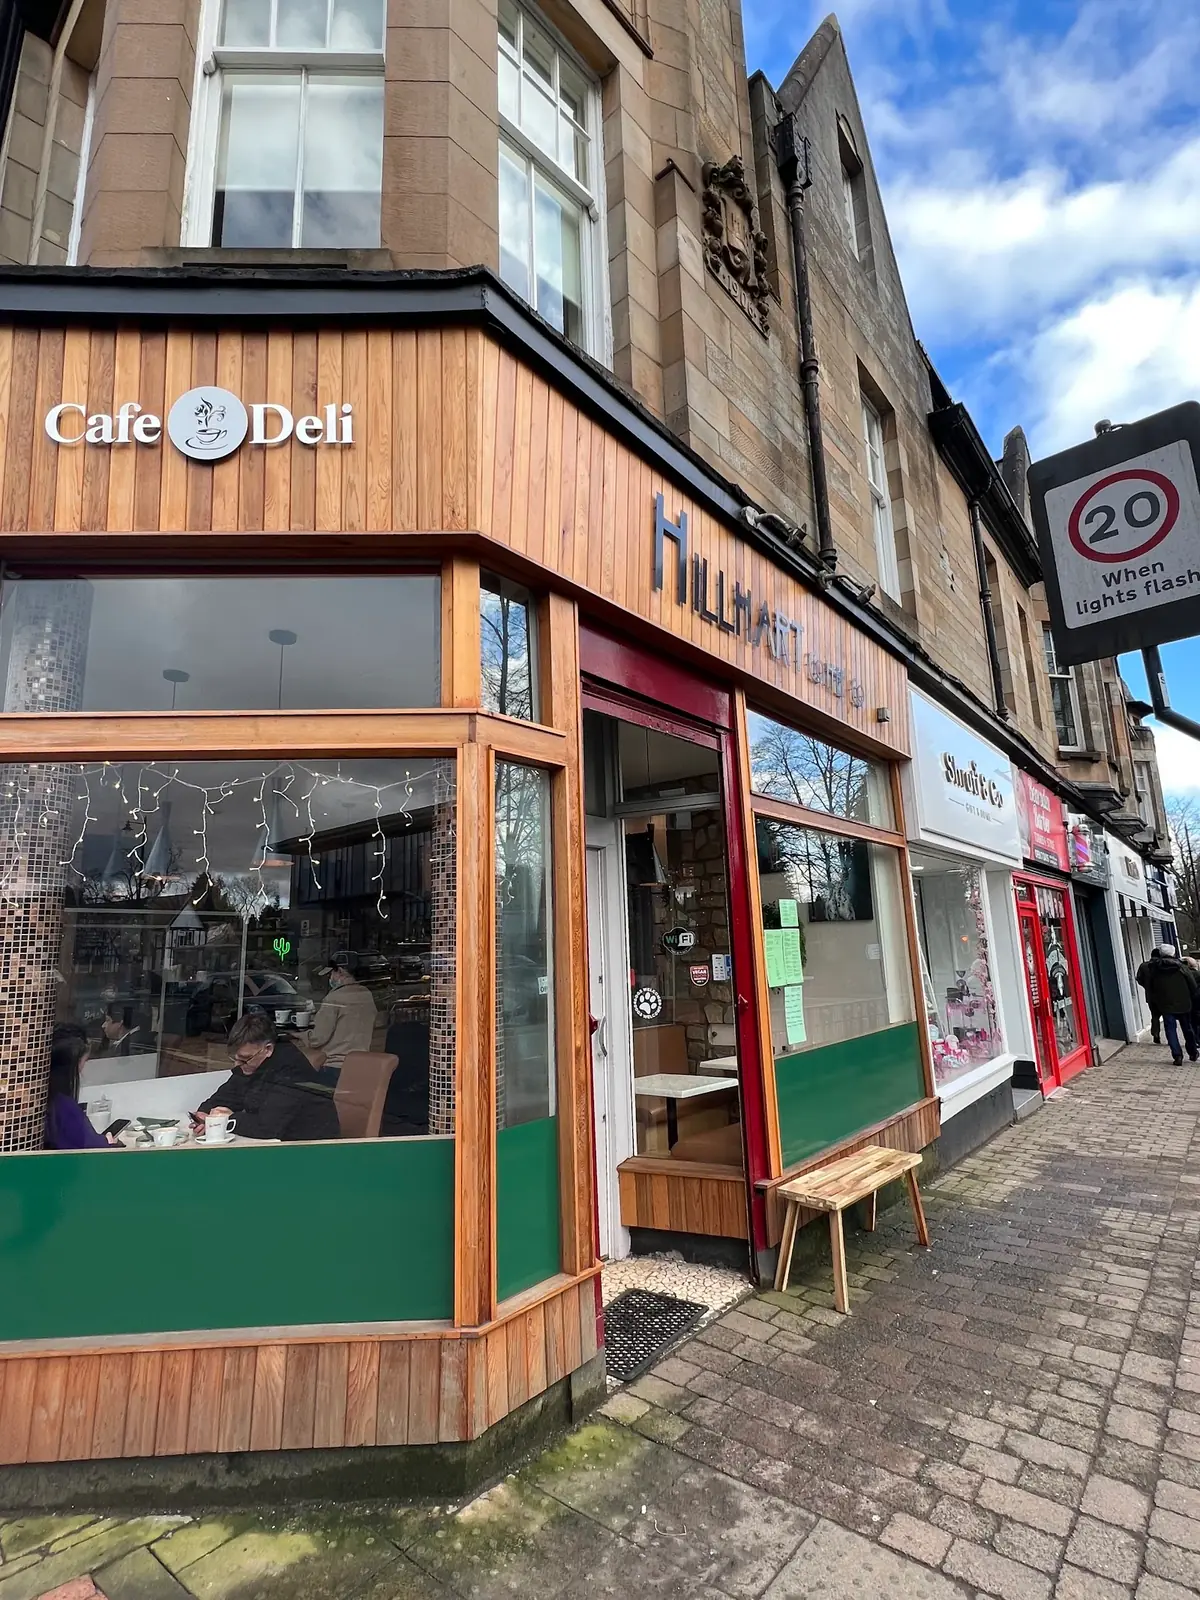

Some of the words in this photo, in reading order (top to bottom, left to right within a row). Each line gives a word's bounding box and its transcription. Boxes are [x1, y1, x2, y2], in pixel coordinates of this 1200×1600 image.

[44, 403, 161, 444] Cafe
[249, 403, 355, 445] Deli
[1084, 491, 1161, 544] 20
[1076, 587, 1137, 615] lights
[1144, 569, 1200, 596] flash
[1102, 561, 1165, 588] When
